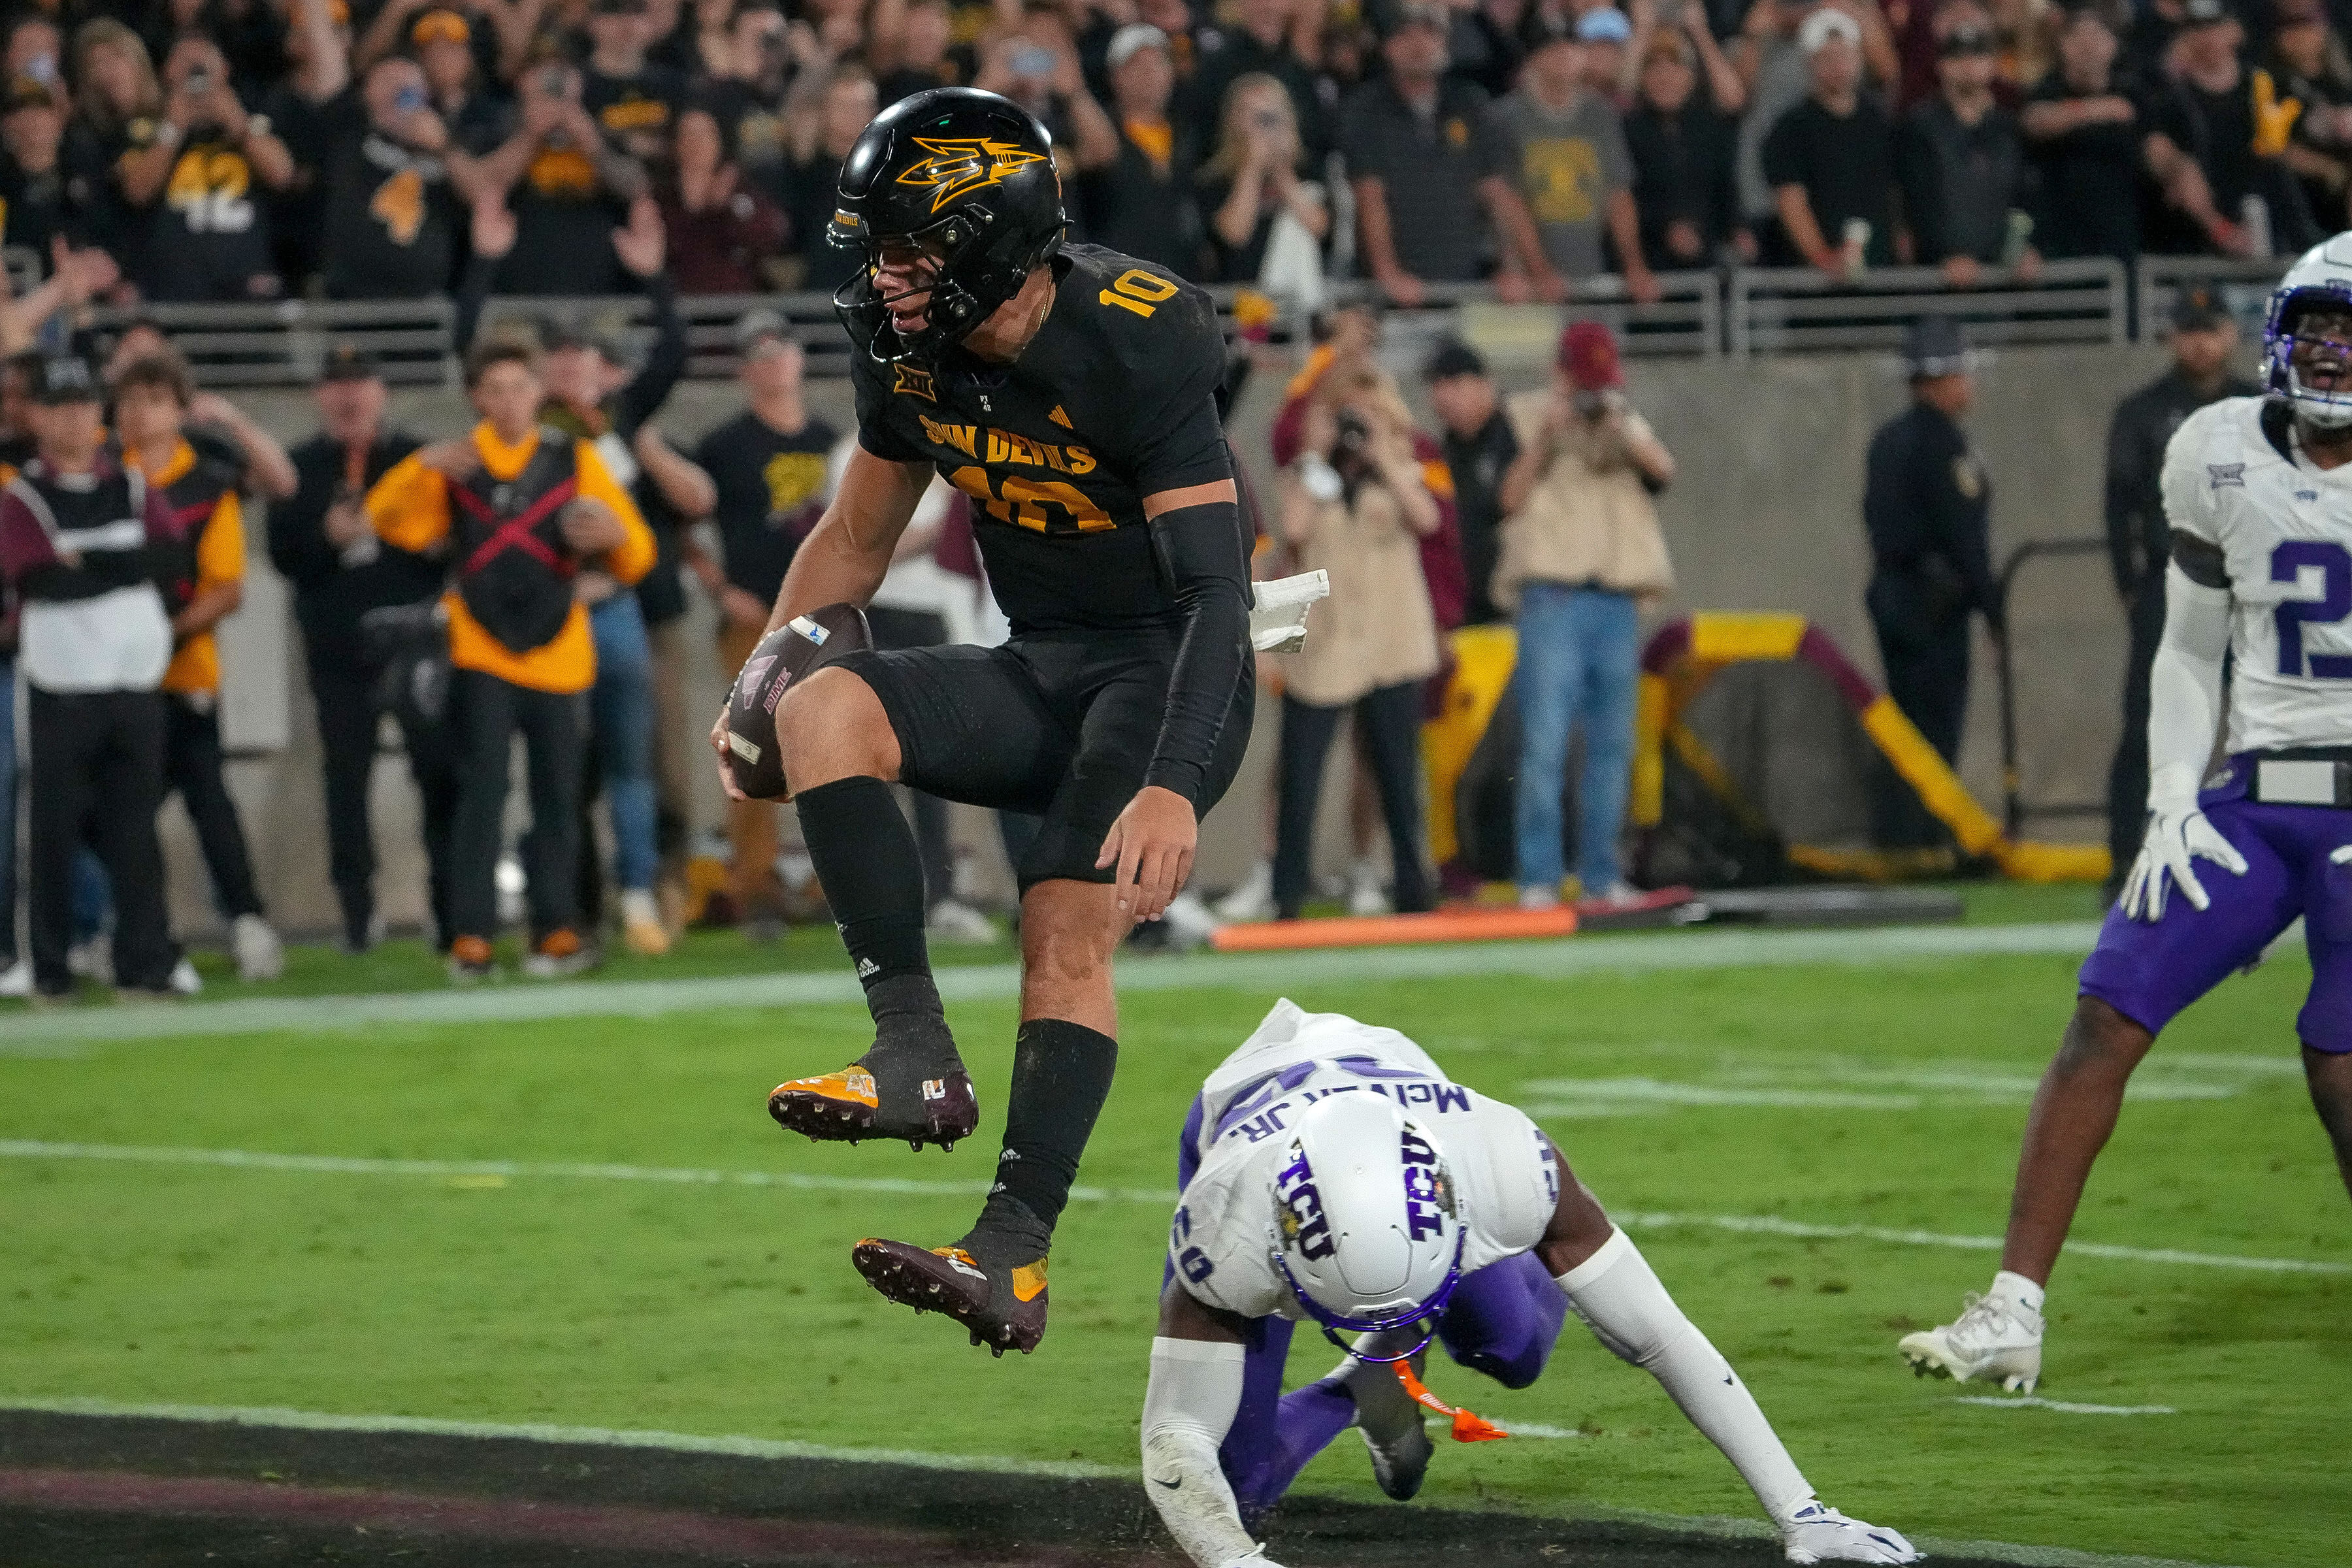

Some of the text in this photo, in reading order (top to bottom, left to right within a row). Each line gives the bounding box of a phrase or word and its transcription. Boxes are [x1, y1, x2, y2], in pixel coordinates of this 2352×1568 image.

[1100, 269, 1179, 318] 10
[919, 414, 1097, 475] SUN DEVILS
[1228, 1102, 1291, 1143] JR.
[1277, 1148, 1335, 1262] TCU
[1400, 1130, 1443, 1242] TCU
